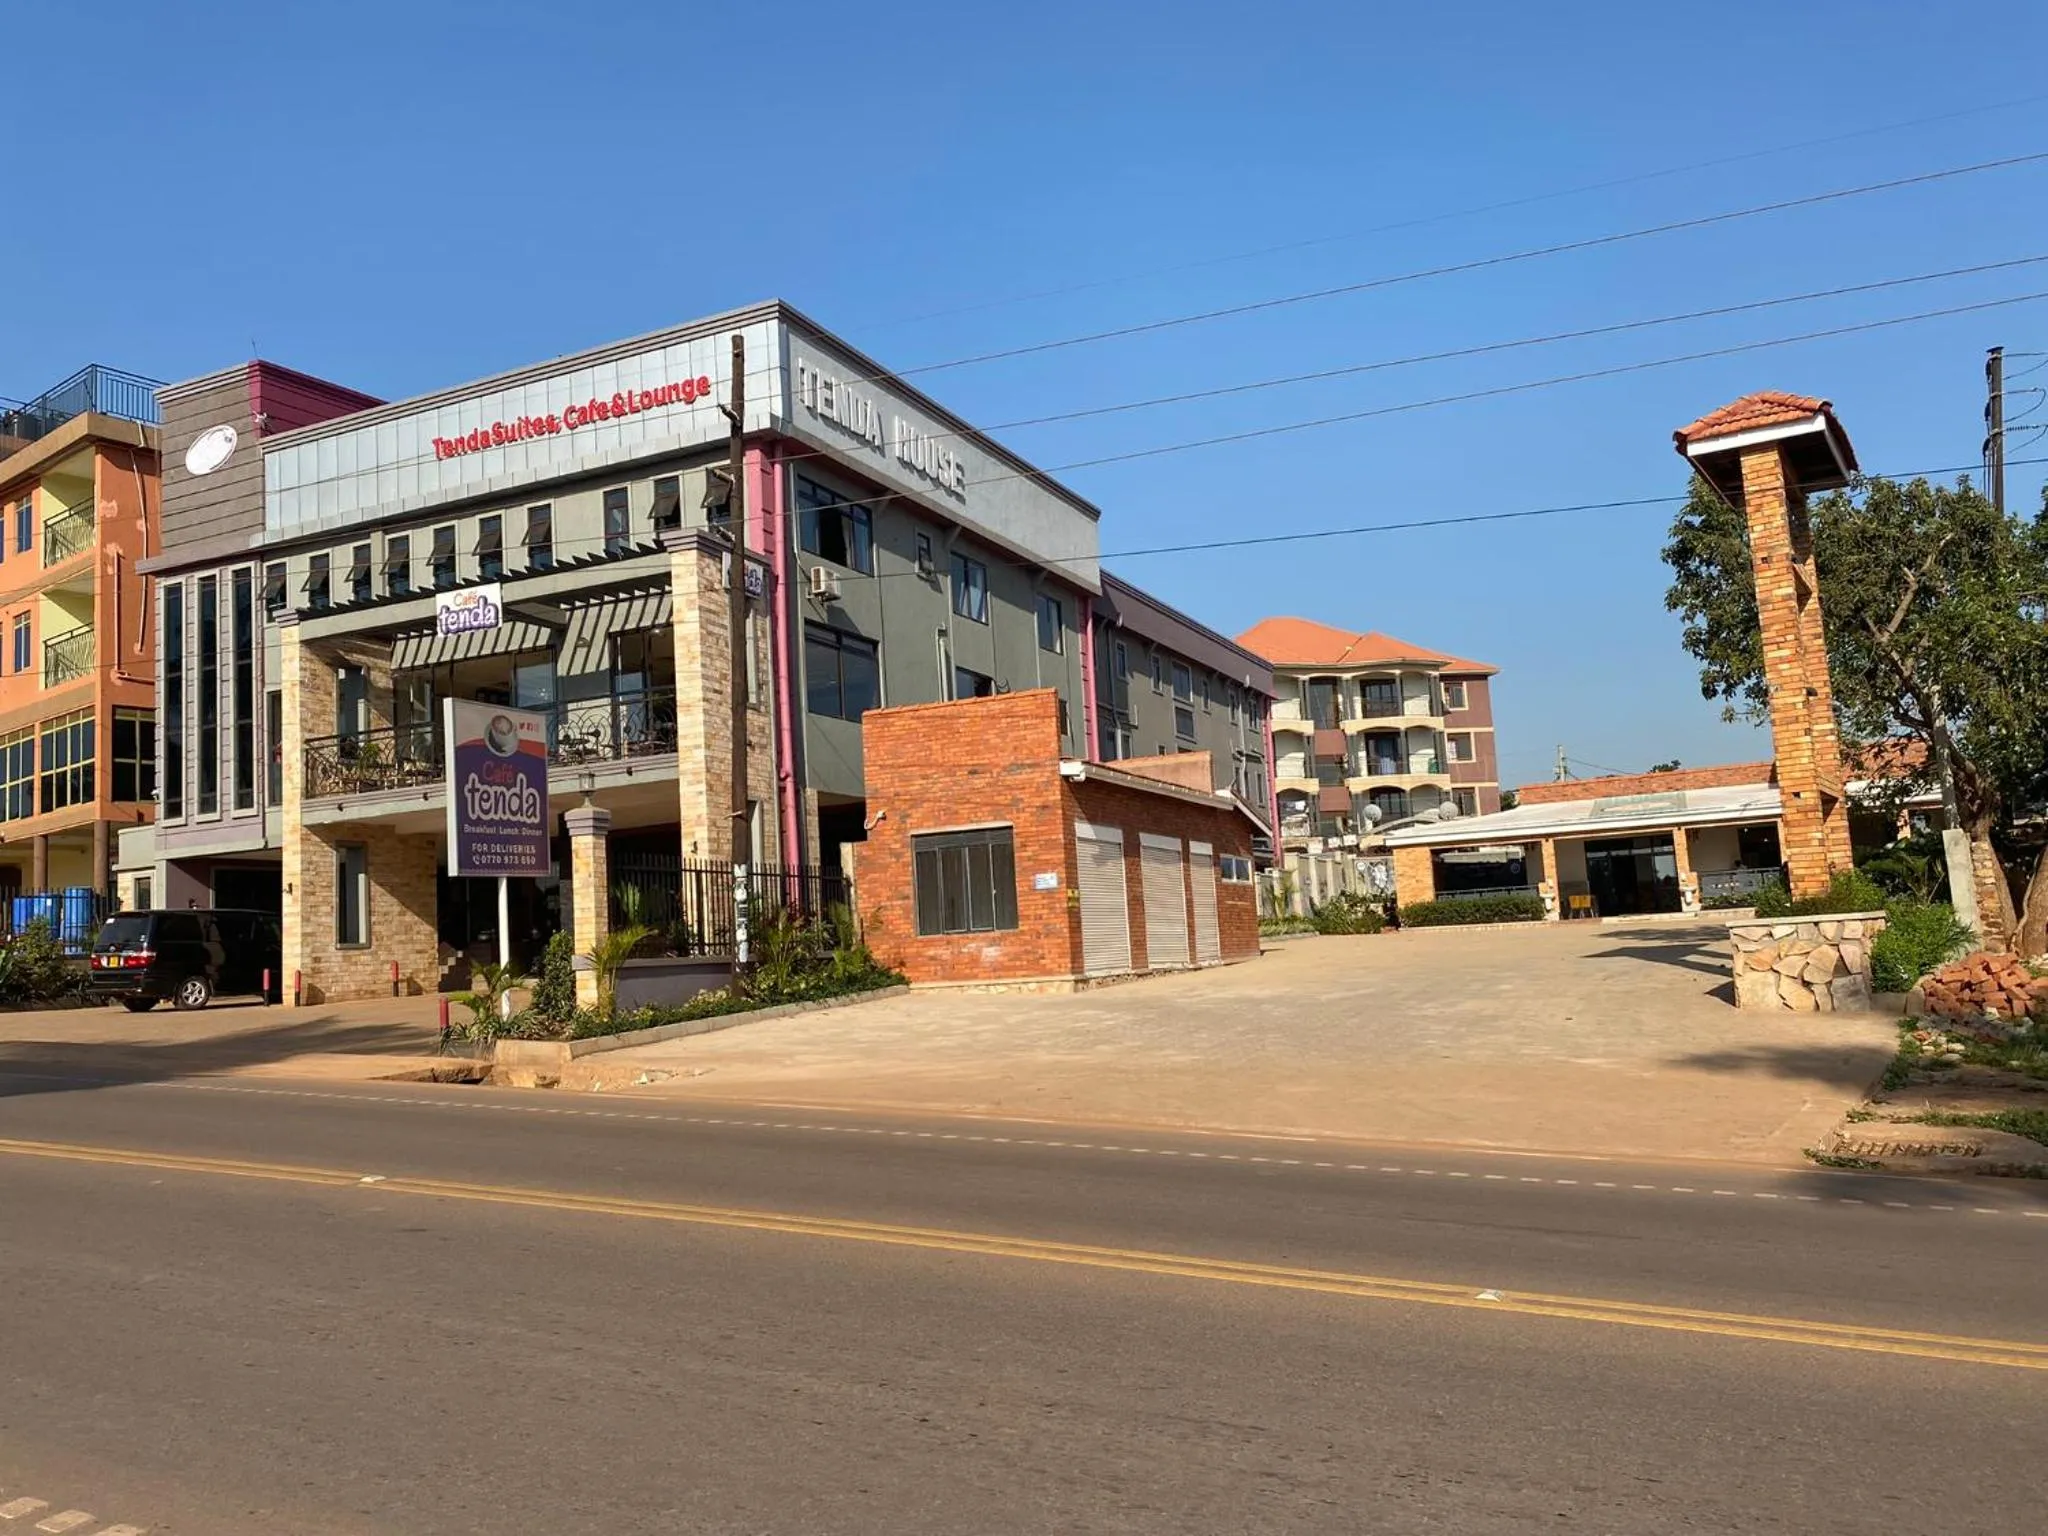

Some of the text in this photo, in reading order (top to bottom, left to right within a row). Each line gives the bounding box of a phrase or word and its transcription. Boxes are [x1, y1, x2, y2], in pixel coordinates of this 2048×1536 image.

[798, 357, 965, 492] TENDA HOUSE
[438, 595, 499, 635] tenda
[464, 773, 540, 824] tenda
[472, 843, 536, 854] FOR DELIVERIES
